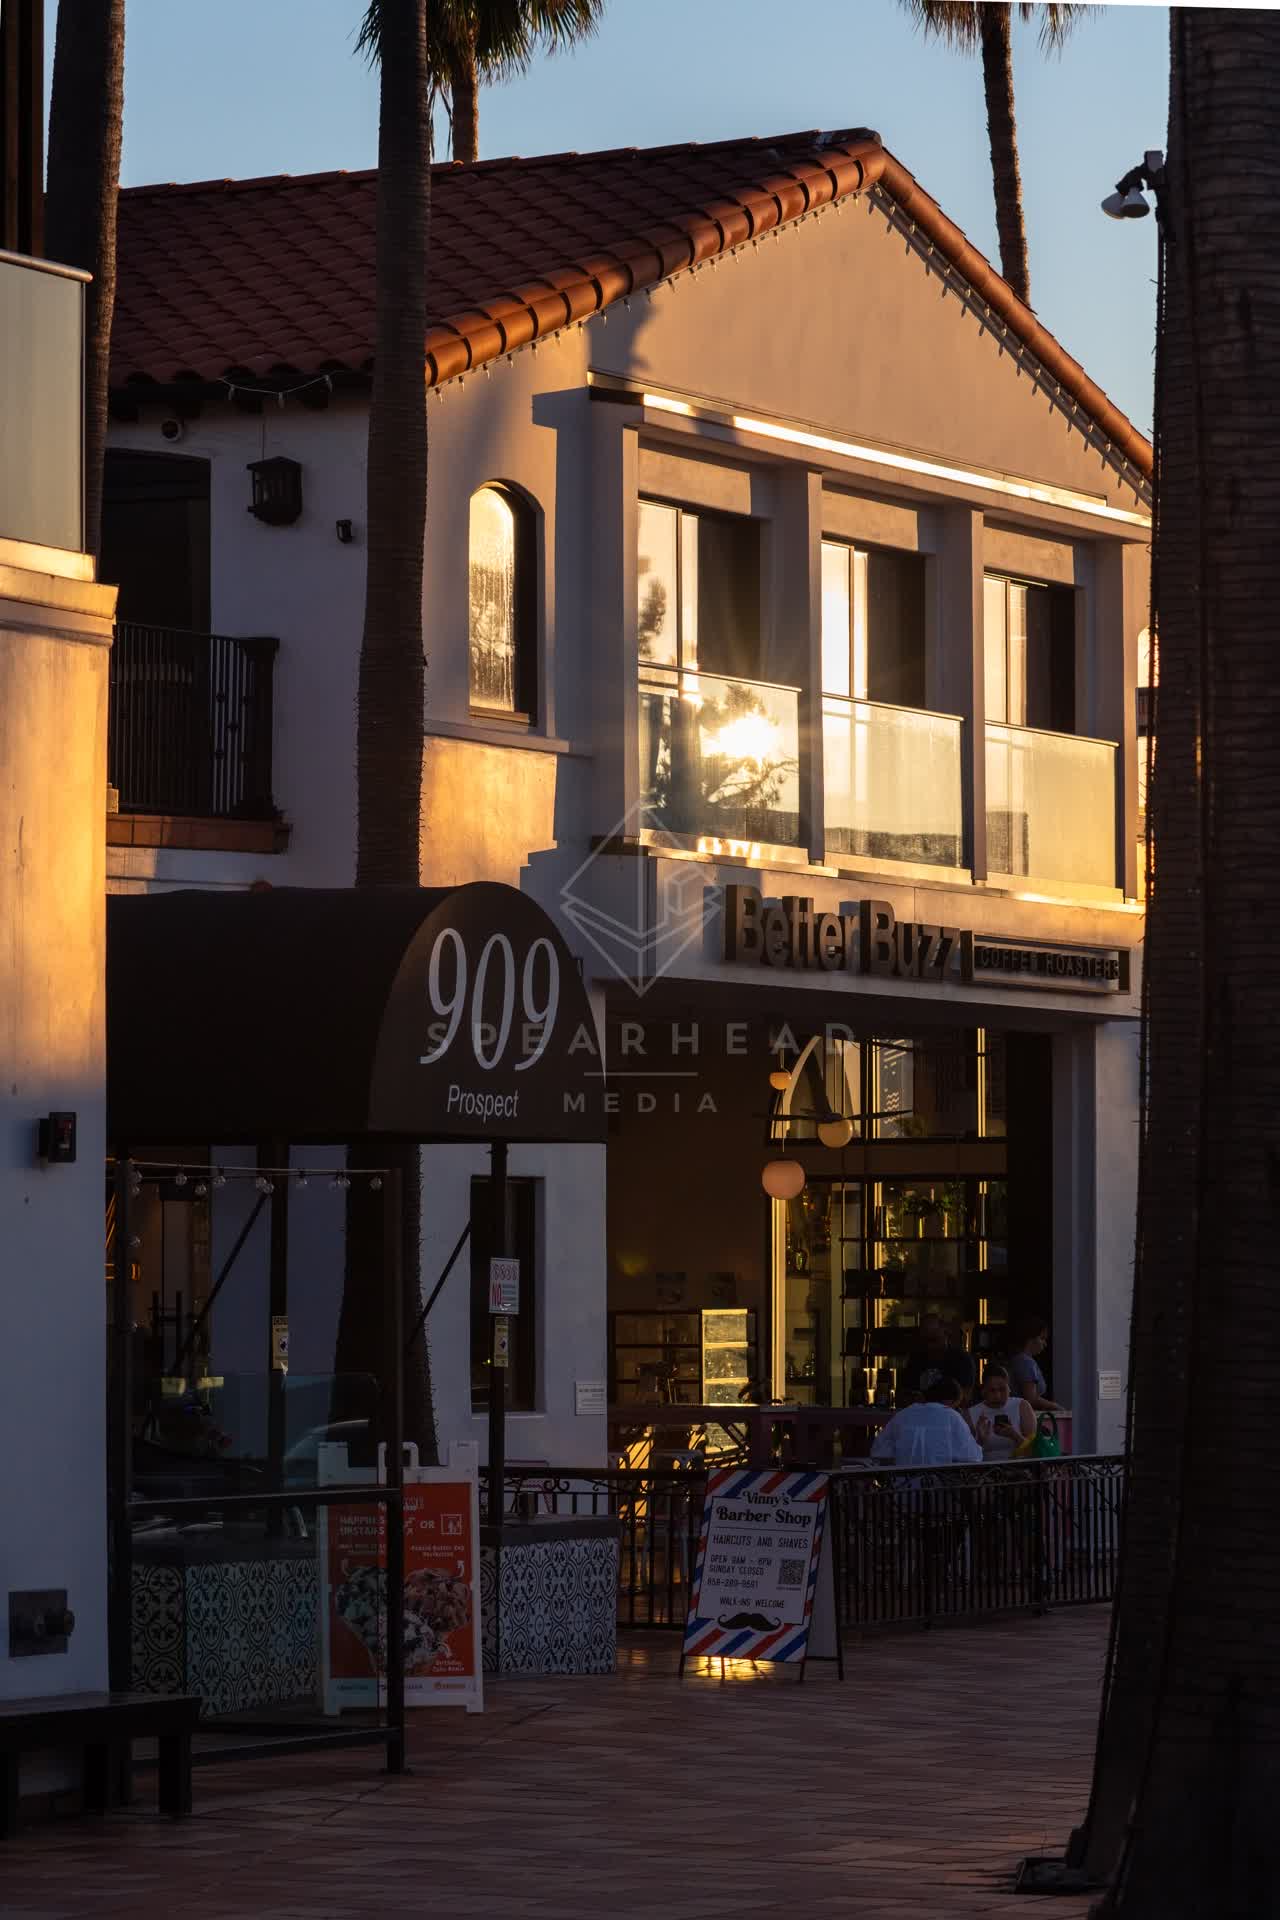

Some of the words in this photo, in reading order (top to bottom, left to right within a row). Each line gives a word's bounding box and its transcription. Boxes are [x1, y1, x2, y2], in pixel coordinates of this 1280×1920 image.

[725, 885, 862, 970] Better
[861, 900, 961, 979] Buzz
[1045, 954, 1120, 979] ROASTERS
[420, 928, 560, 1070] 909
[447, 1084, 519, 1123] Prospect
[742, 1490, 790, 1507] Vinny's
[419, 1519, 436, 1530] OR
[716, 1505, 771, 1523] Barber
[775, 1509, 811, 1528] Shop
[712, 1535, 752, 1547] HAIRCUTS
[757, 1536, 773, 1548] AND
[778, 1537, 809, 1549] SHAVES
[710, 1554, 728, 1564] OPEN
[709, 1564, 735, 1575] SUNDAY
[738, 1566, 765, 1577] CLOSED
[720, 1596, 751, 1607] WALK-INS
[755, 1598, 785, 1609] WELCOME
